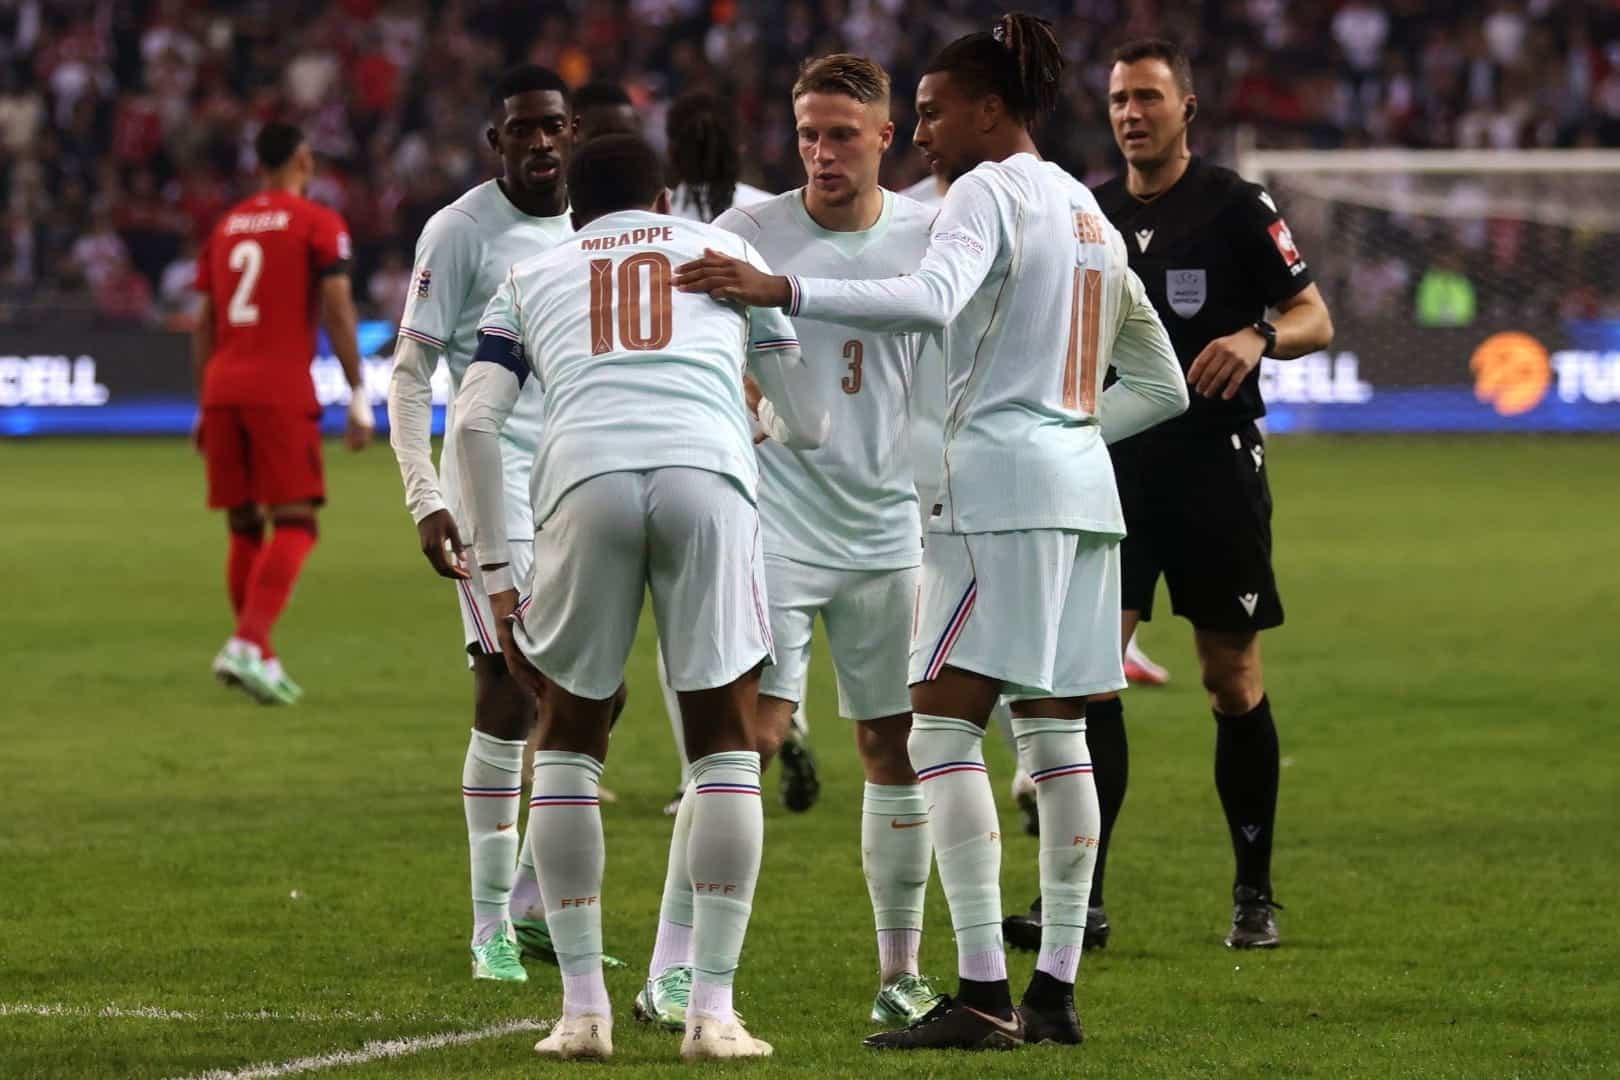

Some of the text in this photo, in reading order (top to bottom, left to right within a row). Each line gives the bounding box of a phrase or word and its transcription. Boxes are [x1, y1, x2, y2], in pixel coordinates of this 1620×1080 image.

[580, 226, 674, 250] MBAPPE
[228, 239, 263, 327] 2
[589, 251, 673, 356] 10
[1061, 266, 1103, 416] 11
[841, 339, 864, 395] 3
[1073, 834, 1100, 848] FF
[560, 896, 598, 909] FFF
[694, 882, 737, 895] FFF
